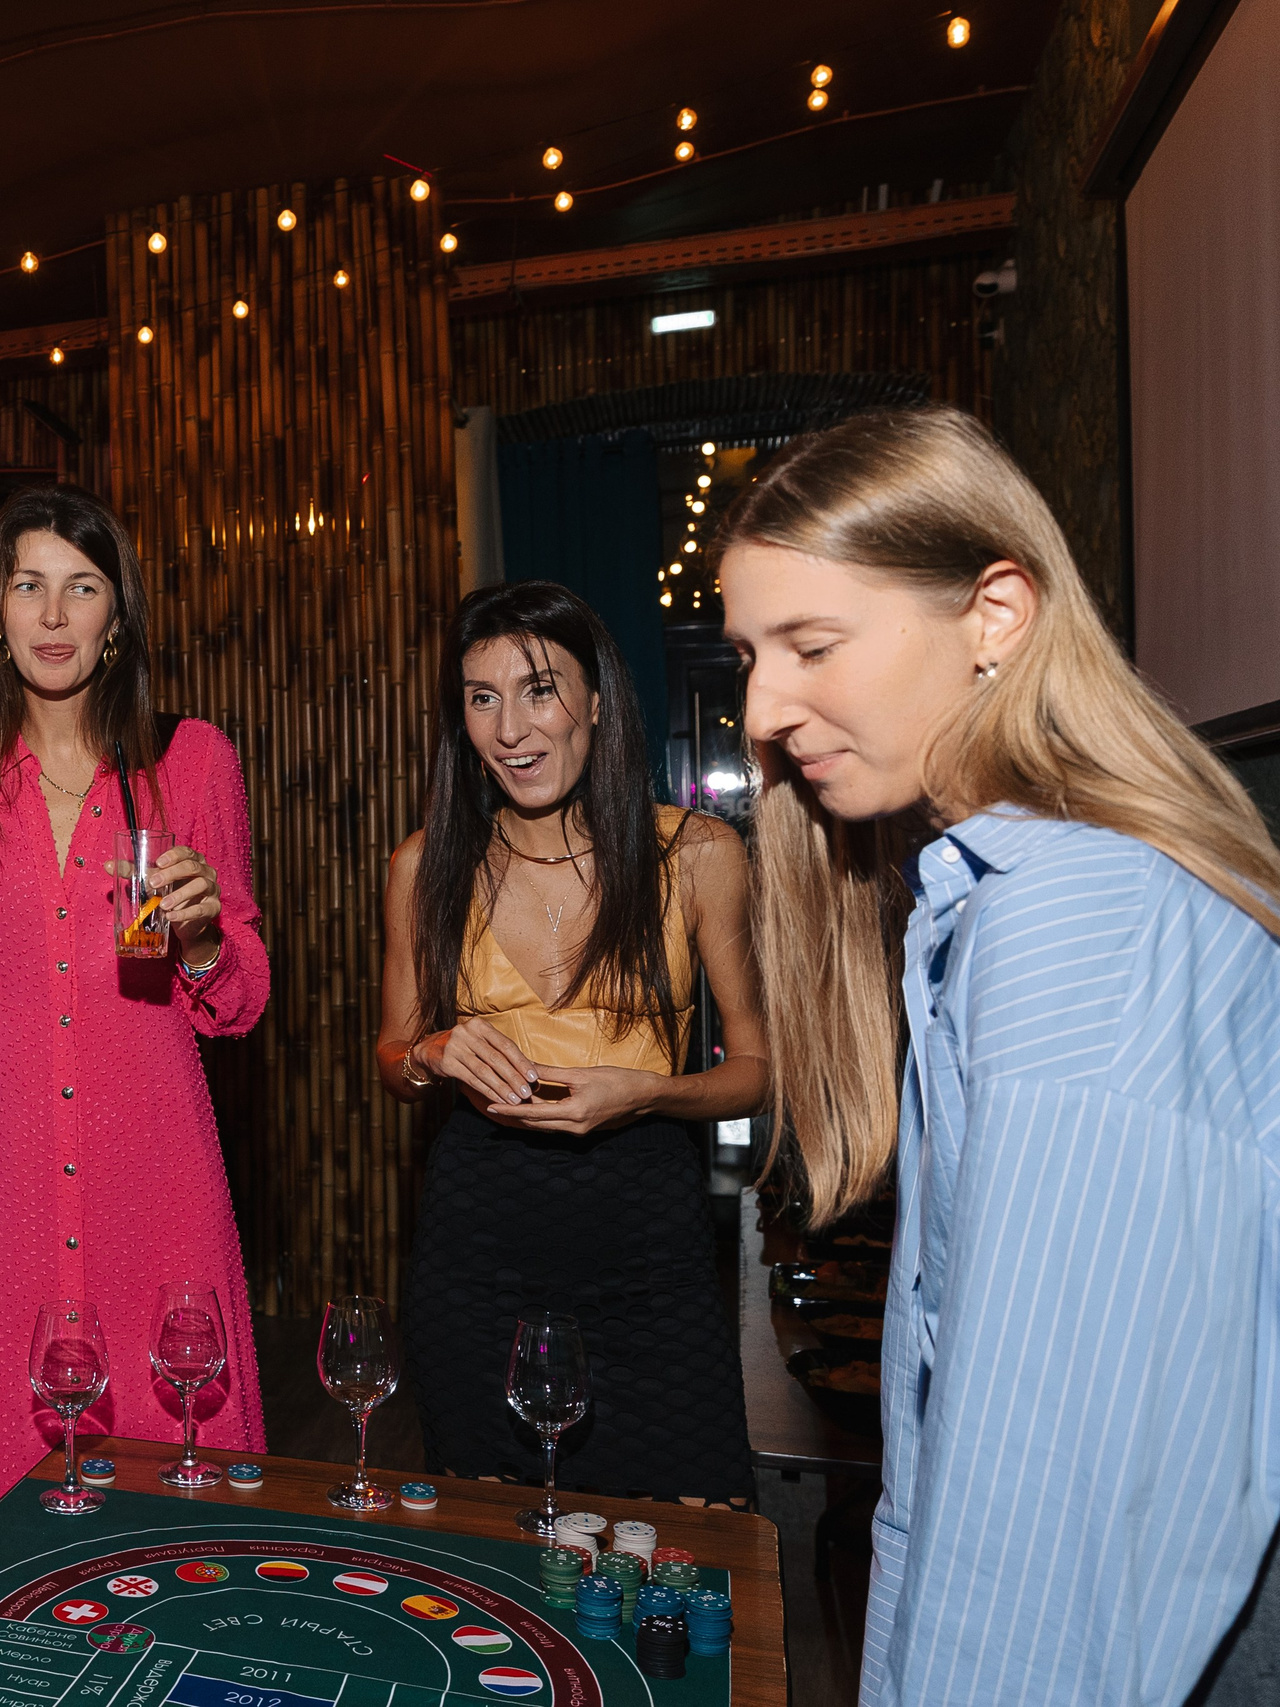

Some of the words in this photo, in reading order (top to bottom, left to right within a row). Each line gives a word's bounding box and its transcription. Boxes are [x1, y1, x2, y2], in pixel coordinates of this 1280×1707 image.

[144, 1545, 225, 1559] Португалия
[249, 1544, 325, 1557] Германия
[78, 1560, 122, 1576] Грузия
[351, 1555, 411, 1573] Австрия
[2, 1580, 60, 1618] Швейцария
[443, 1580, 500, 1608] Испания
[202, 1614, 263, 1631] СВЕТ
[6, 1623, 77, 1640] Каберне
[280, 1617, 373, 1656] СТАРЫЙ
[519, 1621, 556, 1649] Италия
[7, 1673, 51, 1688] Нуар
[240, 1666, 292, 1682] 2011
[80, 1673, 113, 1696] 11%
[224, 1691, 282, 1707] 2012
